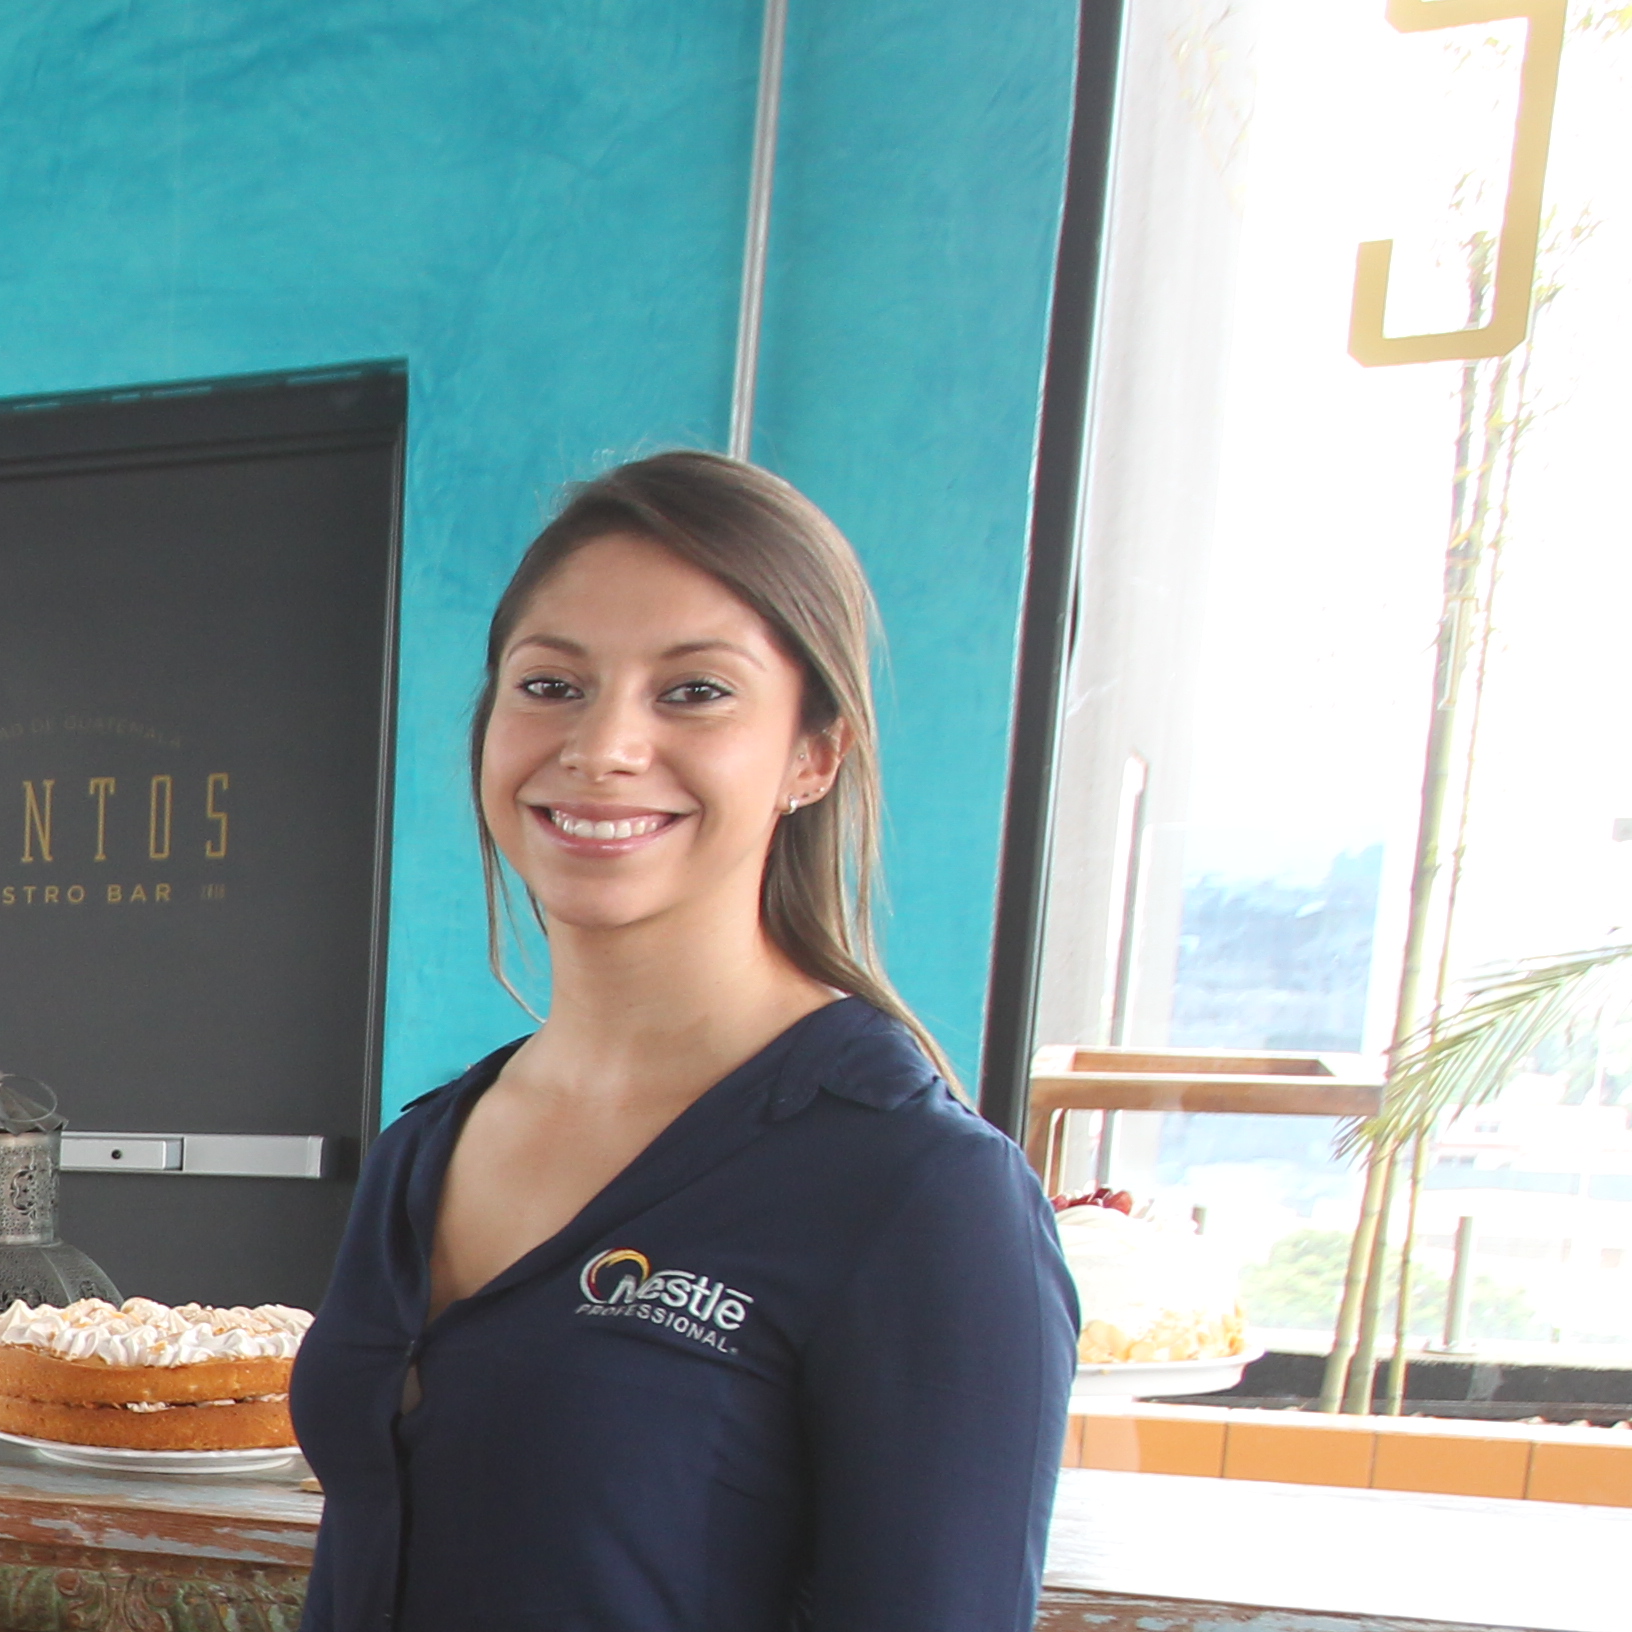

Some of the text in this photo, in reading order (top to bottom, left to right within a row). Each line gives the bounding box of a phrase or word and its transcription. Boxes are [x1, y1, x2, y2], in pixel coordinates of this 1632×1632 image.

[30, 716, 57, 735] DE
[63, 714, 184, 750] GUATEMALA
[107, 882, 172, 903] BAR
[575, 1302, 730, 1353] PROFESSIONAL
